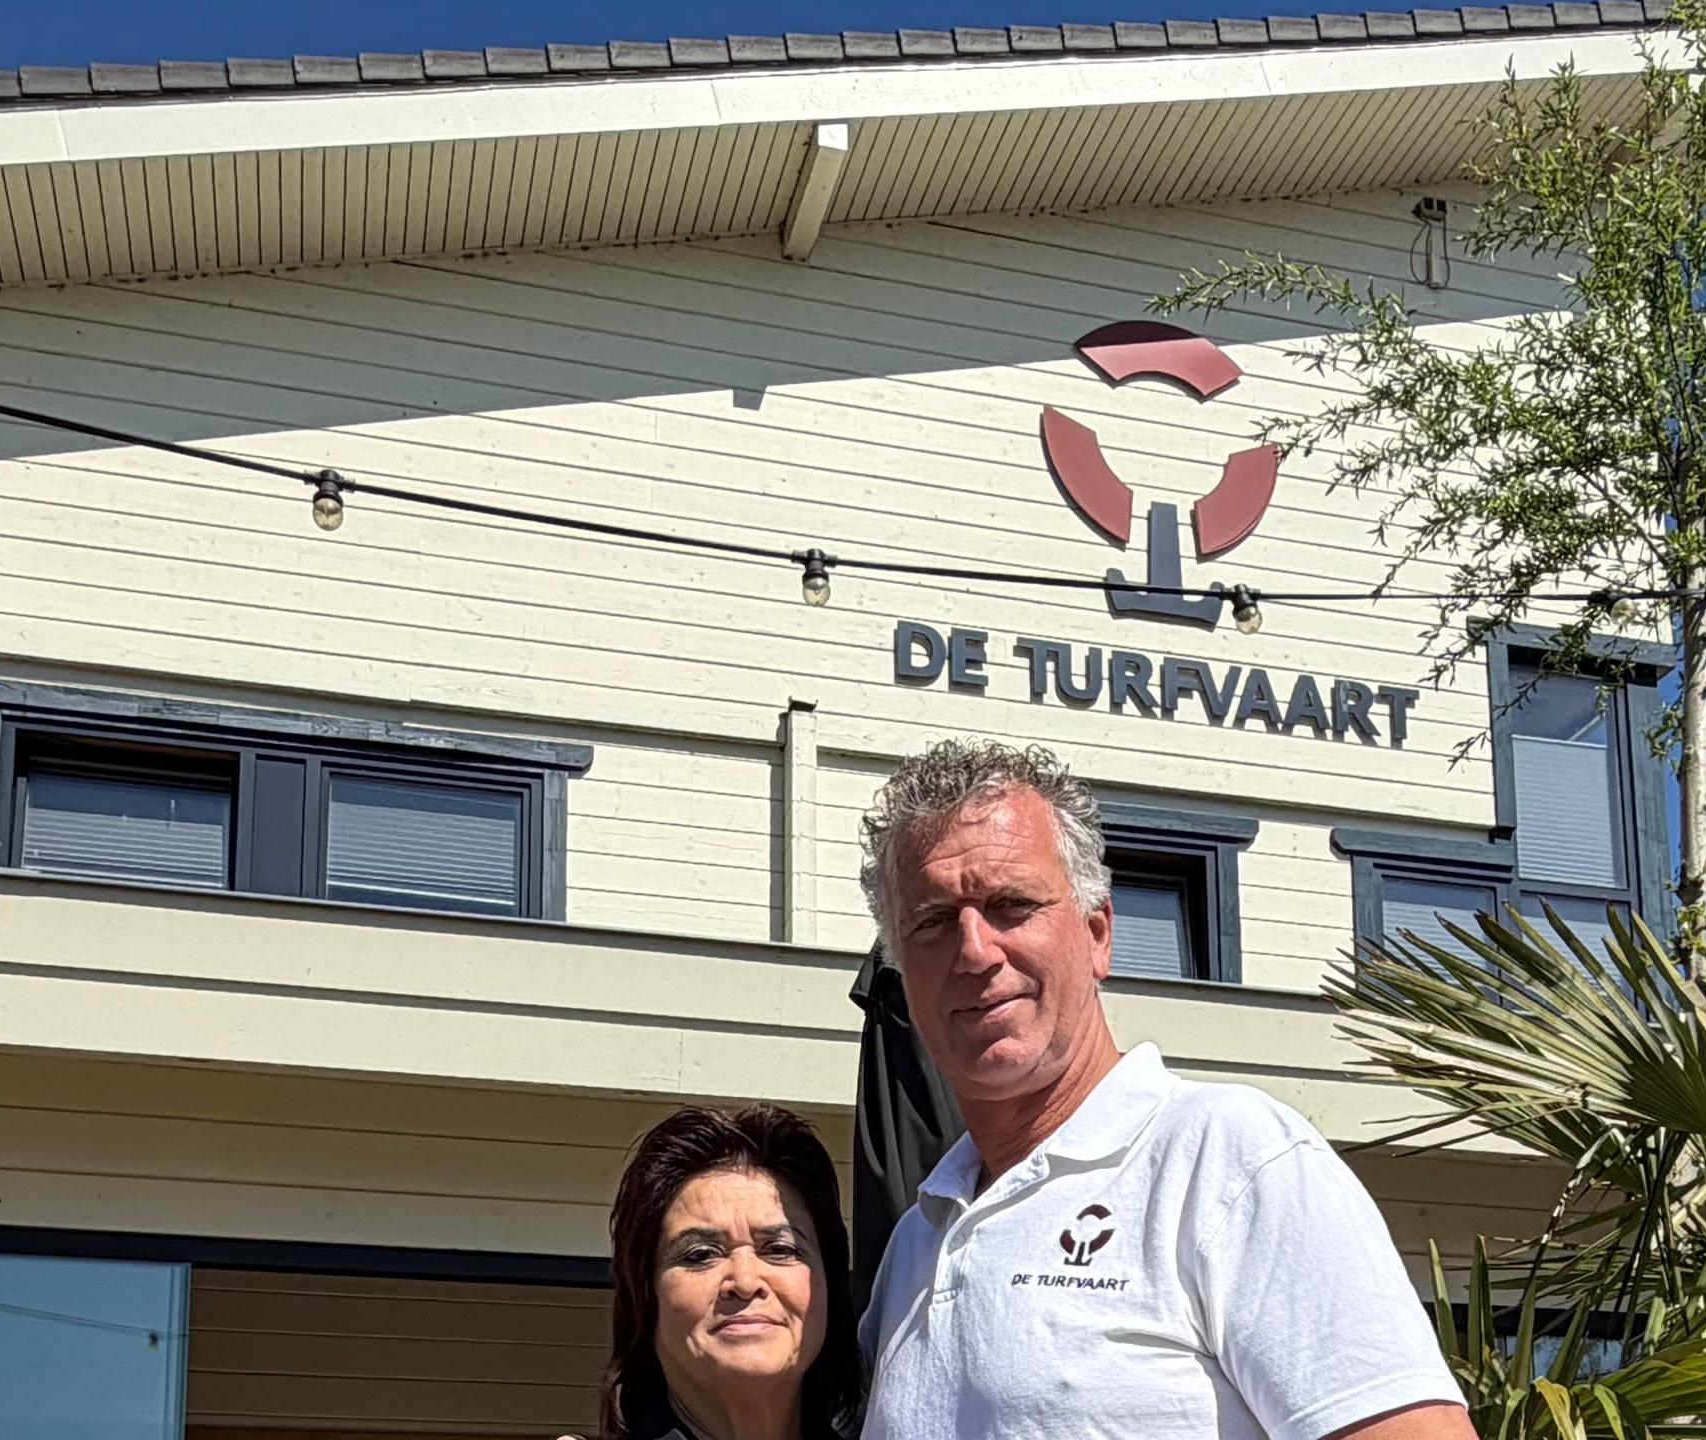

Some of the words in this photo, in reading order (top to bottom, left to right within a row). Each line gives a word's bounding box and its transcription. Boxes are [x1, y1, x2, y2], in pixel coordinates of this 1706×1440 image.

[894, 619, 990, 694] DE
[1014, 636, 1420, 748] TURFVAART
[1012, 1273, 1033, 1286] DE
[1037, 1274, 1130, 1291] TURFVAART
